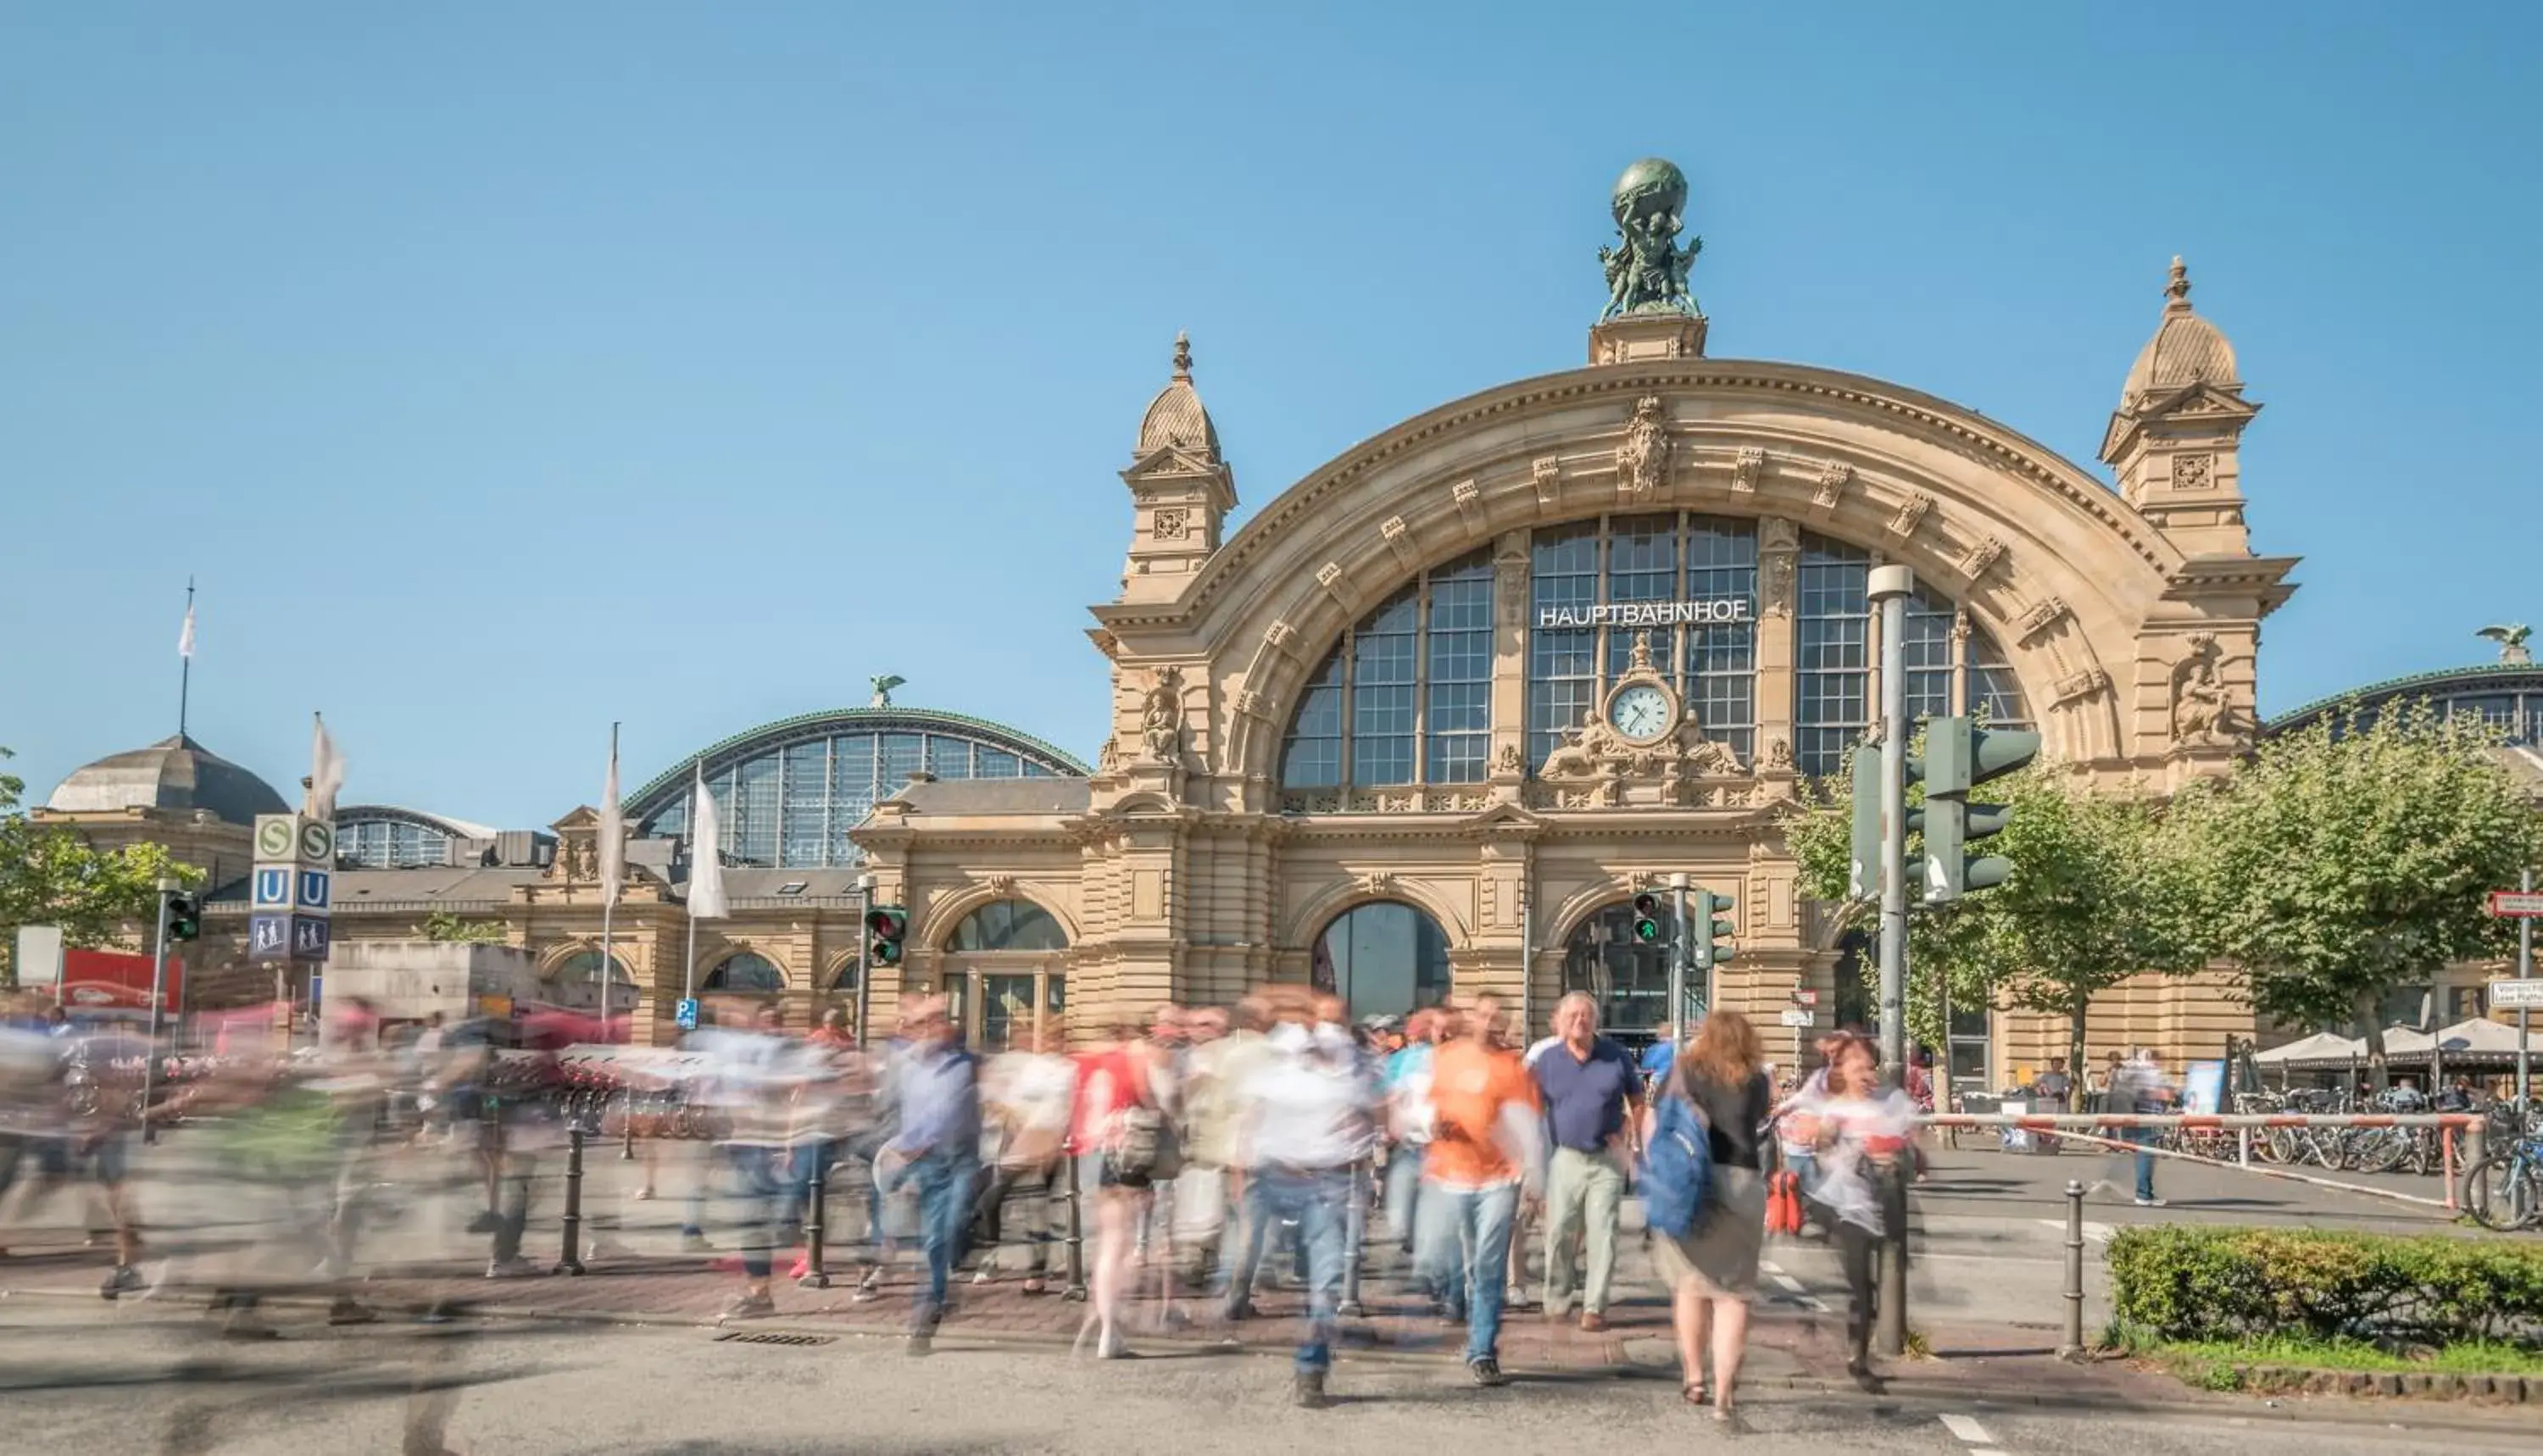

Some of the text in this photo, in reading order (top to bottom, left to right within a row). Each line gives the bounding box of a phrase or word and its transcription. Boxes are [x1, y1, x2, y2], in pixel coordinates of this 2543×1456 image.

[1539, 599, 1748, 626] HAUPTBAHNHOF
[263, 821, 288, 854] S
[303, 825, 327, 858] S
[263, 871, 285, 903] U
[303, 874, 324, 904] U
[678, 1002, 689, 1018] P
